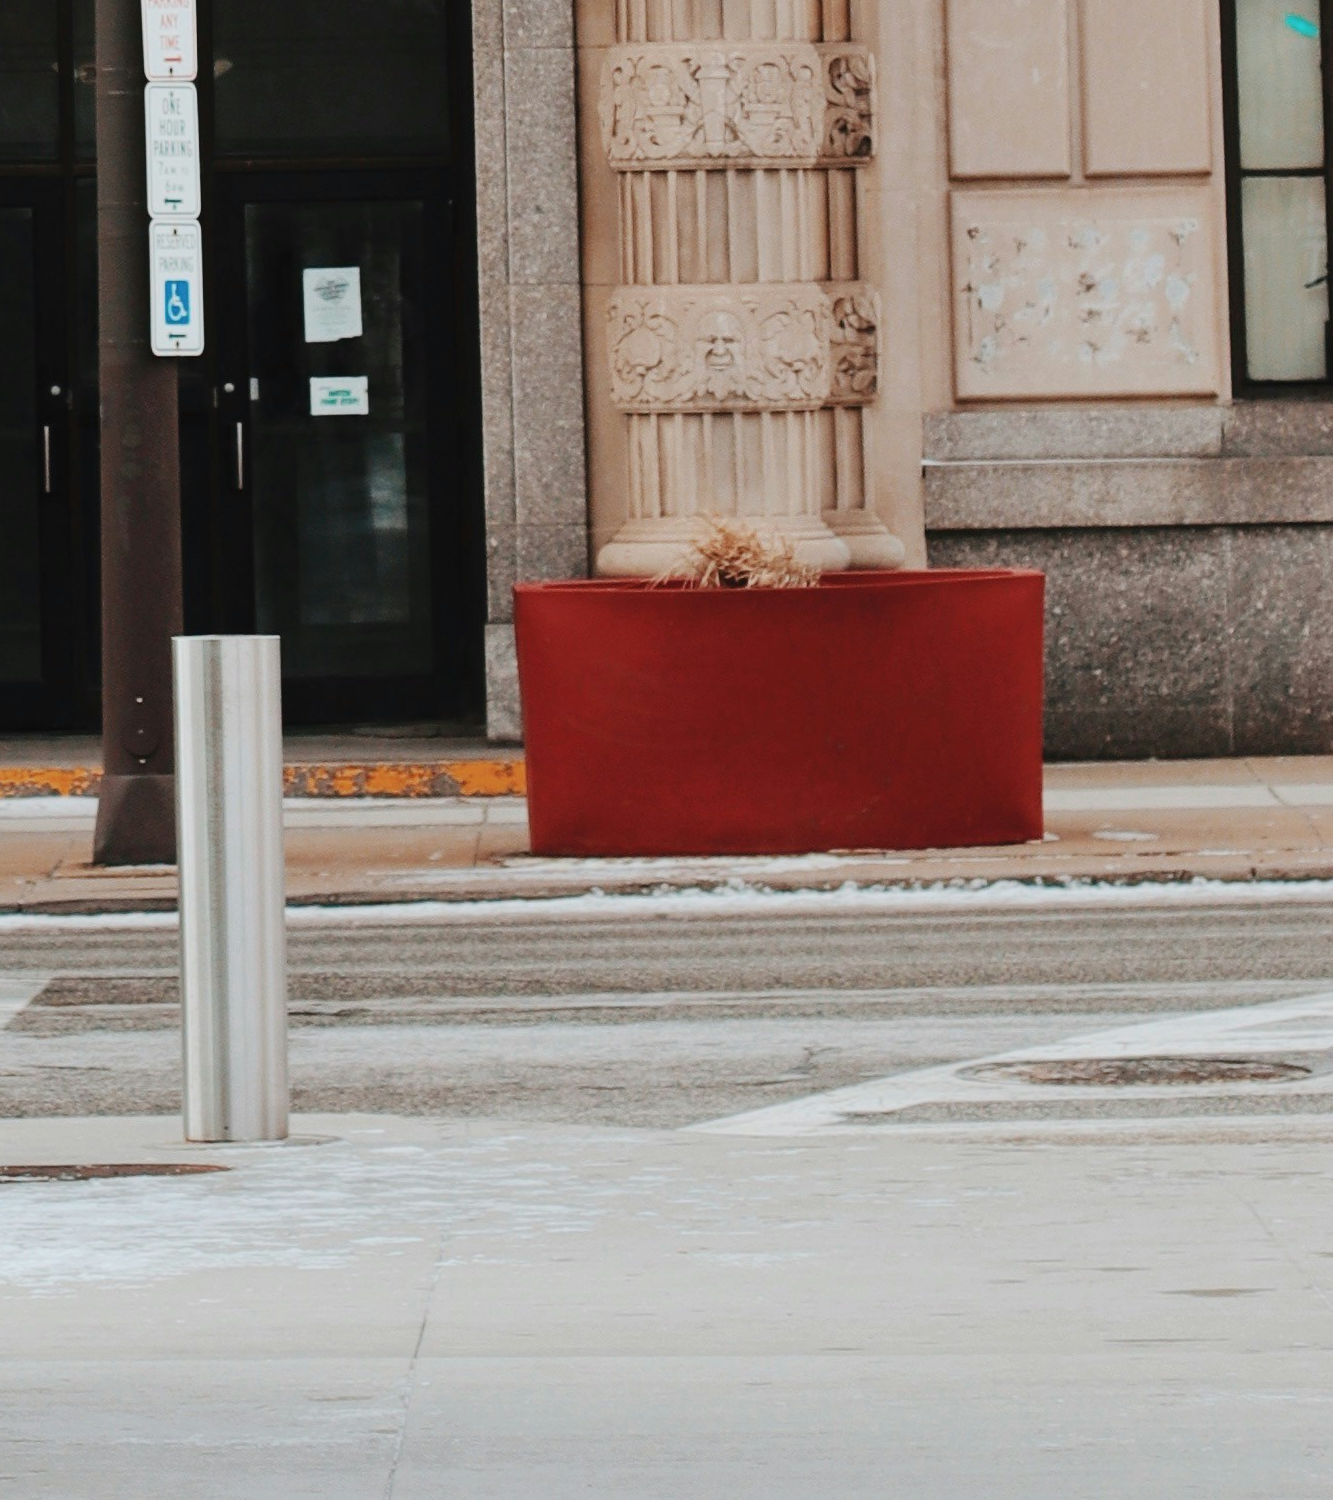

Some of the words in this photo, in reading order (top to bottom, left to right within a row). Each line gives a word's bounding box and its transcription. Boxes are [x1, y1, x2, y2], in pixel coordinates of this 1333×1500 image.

[161, 14, 178, 28] ANY
[160, 35, 181, 50] TIME
[162, 98, 181, 115] ONE
[160, 119, 185, 136] HOUR
[154, 140, 192, 157] PARKING
